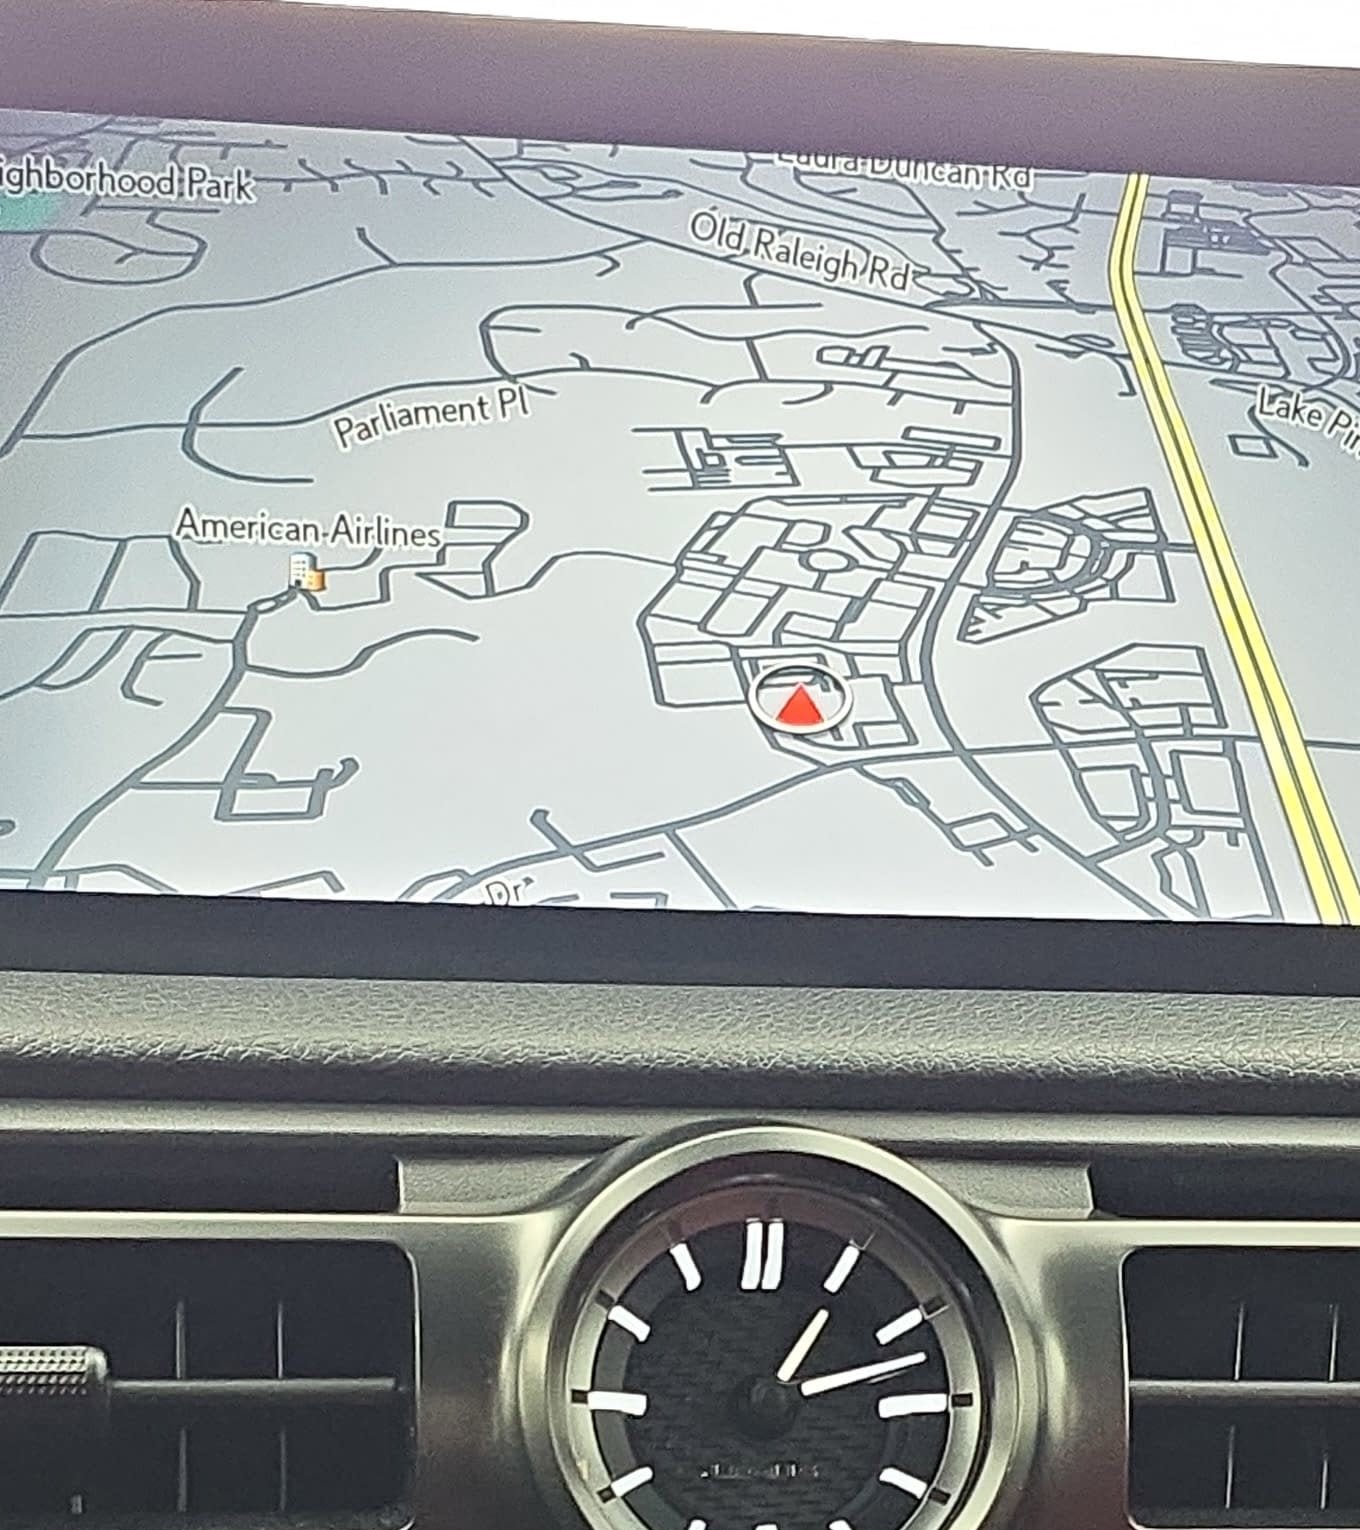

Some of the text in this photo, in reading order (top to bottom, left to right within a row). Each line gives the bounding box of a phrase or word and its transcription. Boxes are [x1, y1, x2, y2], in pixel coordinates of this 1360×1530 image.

[189, 171, 254, 201] Park
[870, 158, 980, 187] Duncan
[992, 164, 1031, 188] Rd
[691, 210, 910, 291] Old Raleigh Rd
[336, 386, 529, 448] Parliament Pl
[1259, 387, 1324, 432] Lake
[177, 508, 441, 547] American Airlines
[485, 881, 521, 906] Dr
